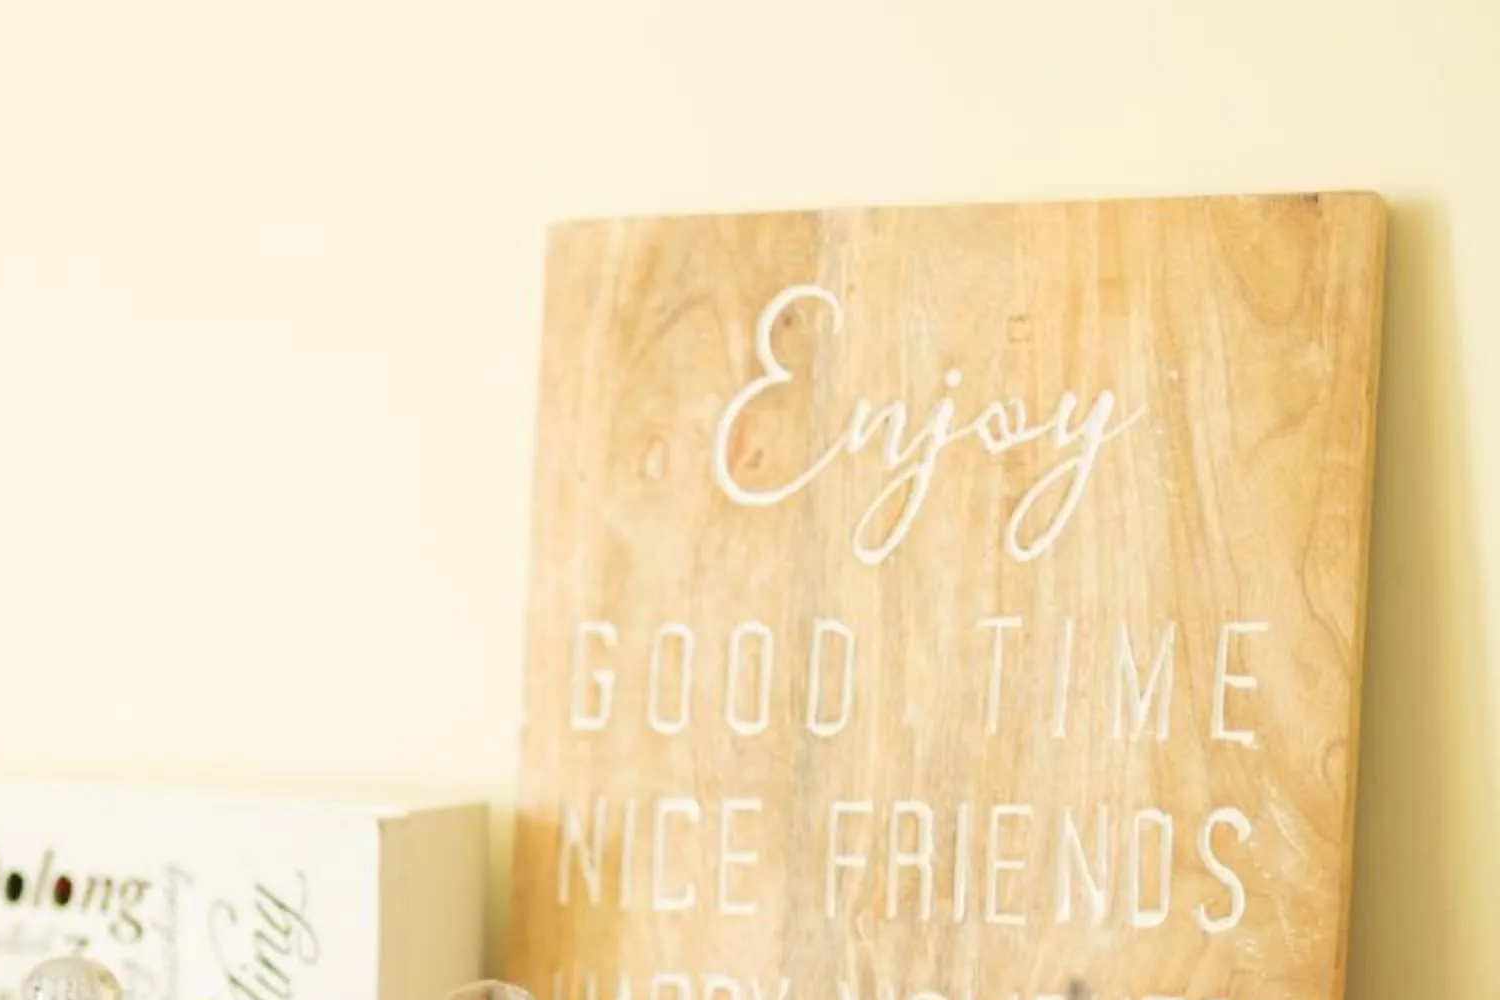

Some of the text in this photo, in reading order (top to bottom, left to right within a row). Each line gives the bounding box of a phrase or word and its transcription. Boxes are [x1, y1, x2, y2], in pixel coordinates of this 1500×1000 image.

[712, 283, 1144, 565] Enjoy
[569, 615, 1270, 749] GOOD TIME
[556, 796, 1253, 934] NICE FRIENDS
